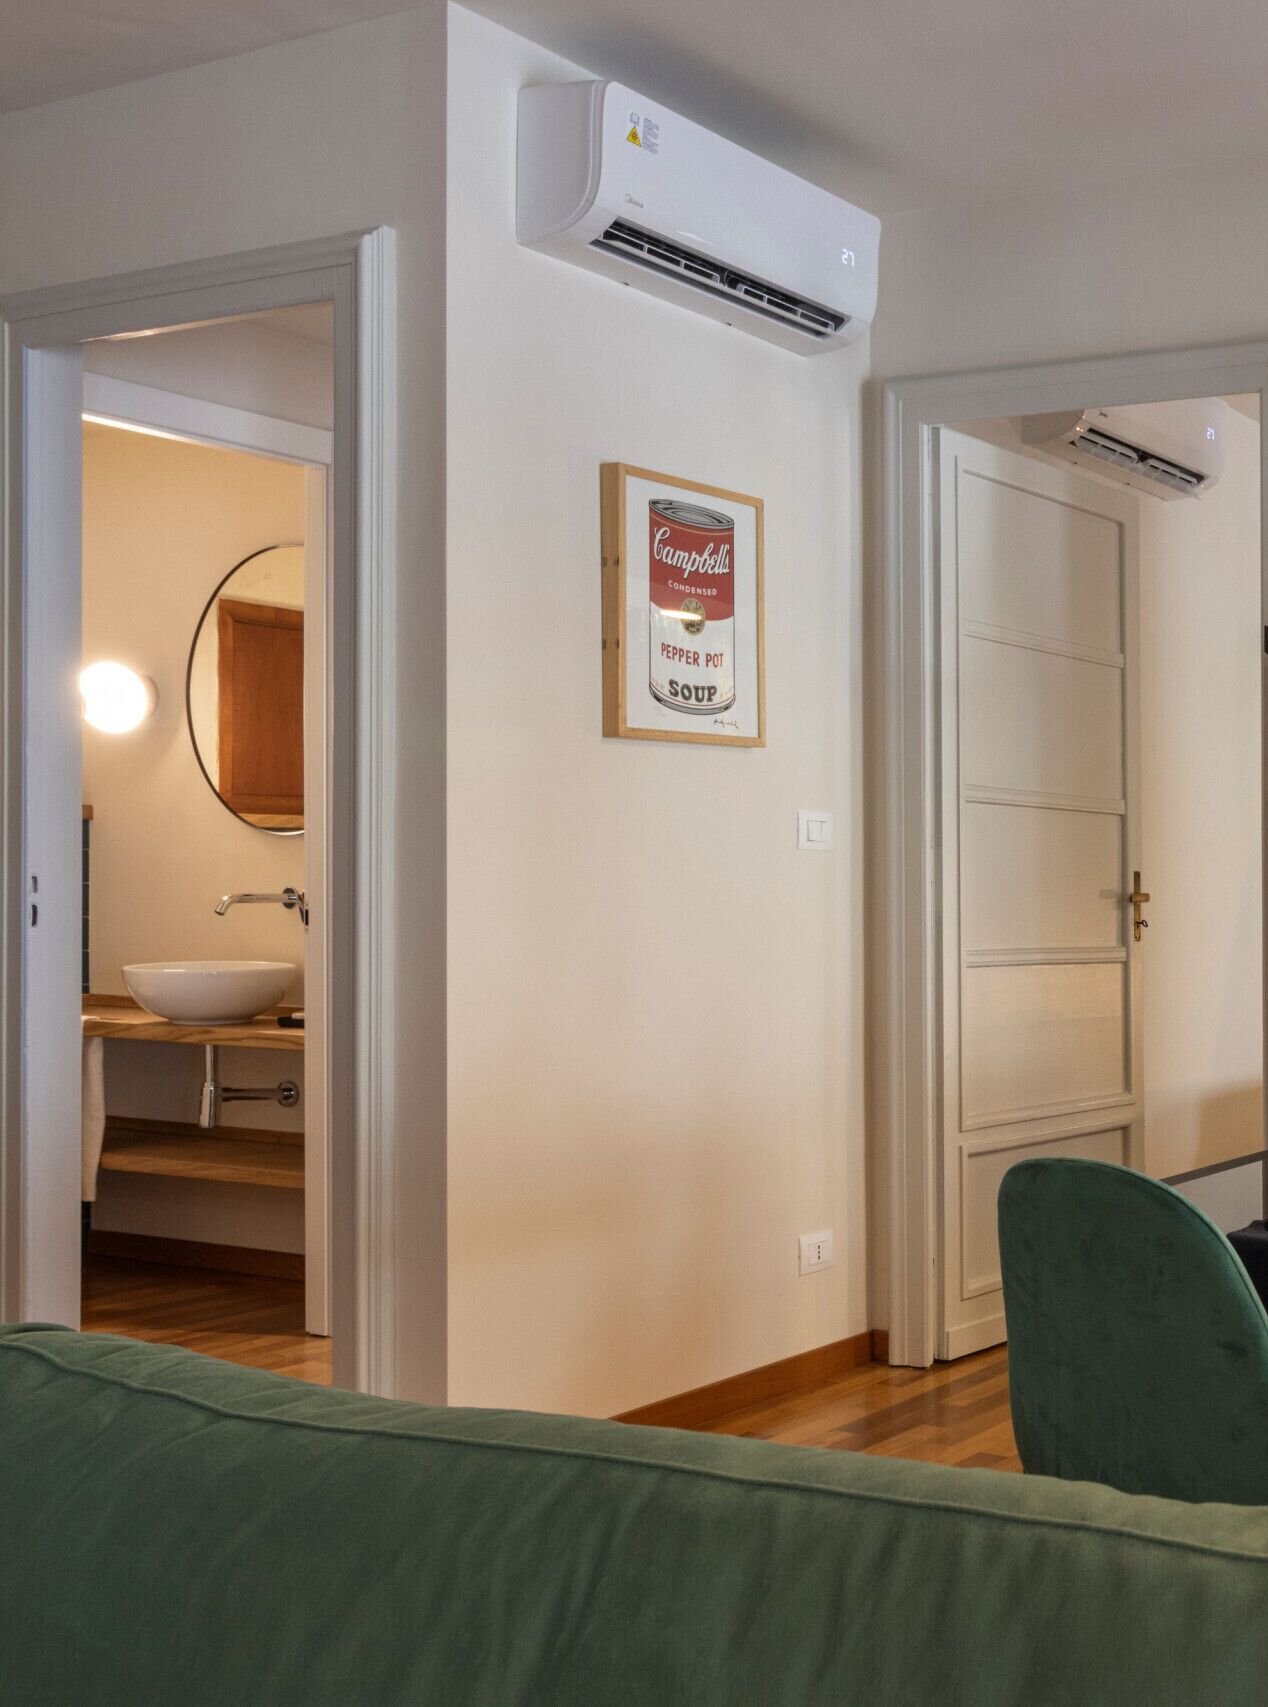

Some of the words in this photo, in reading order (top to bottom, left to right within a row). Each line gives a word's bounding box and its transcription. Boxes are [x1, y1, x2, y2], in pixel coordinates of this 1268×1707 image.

[654, 527, 730, 579] Campbell's
[667, 580, 718, 596] CONDENSED
[661, 642, 700, 667] PEPPER
[705, 652, 724, 668] POT
[668, 679, 718, 703] SOUP
